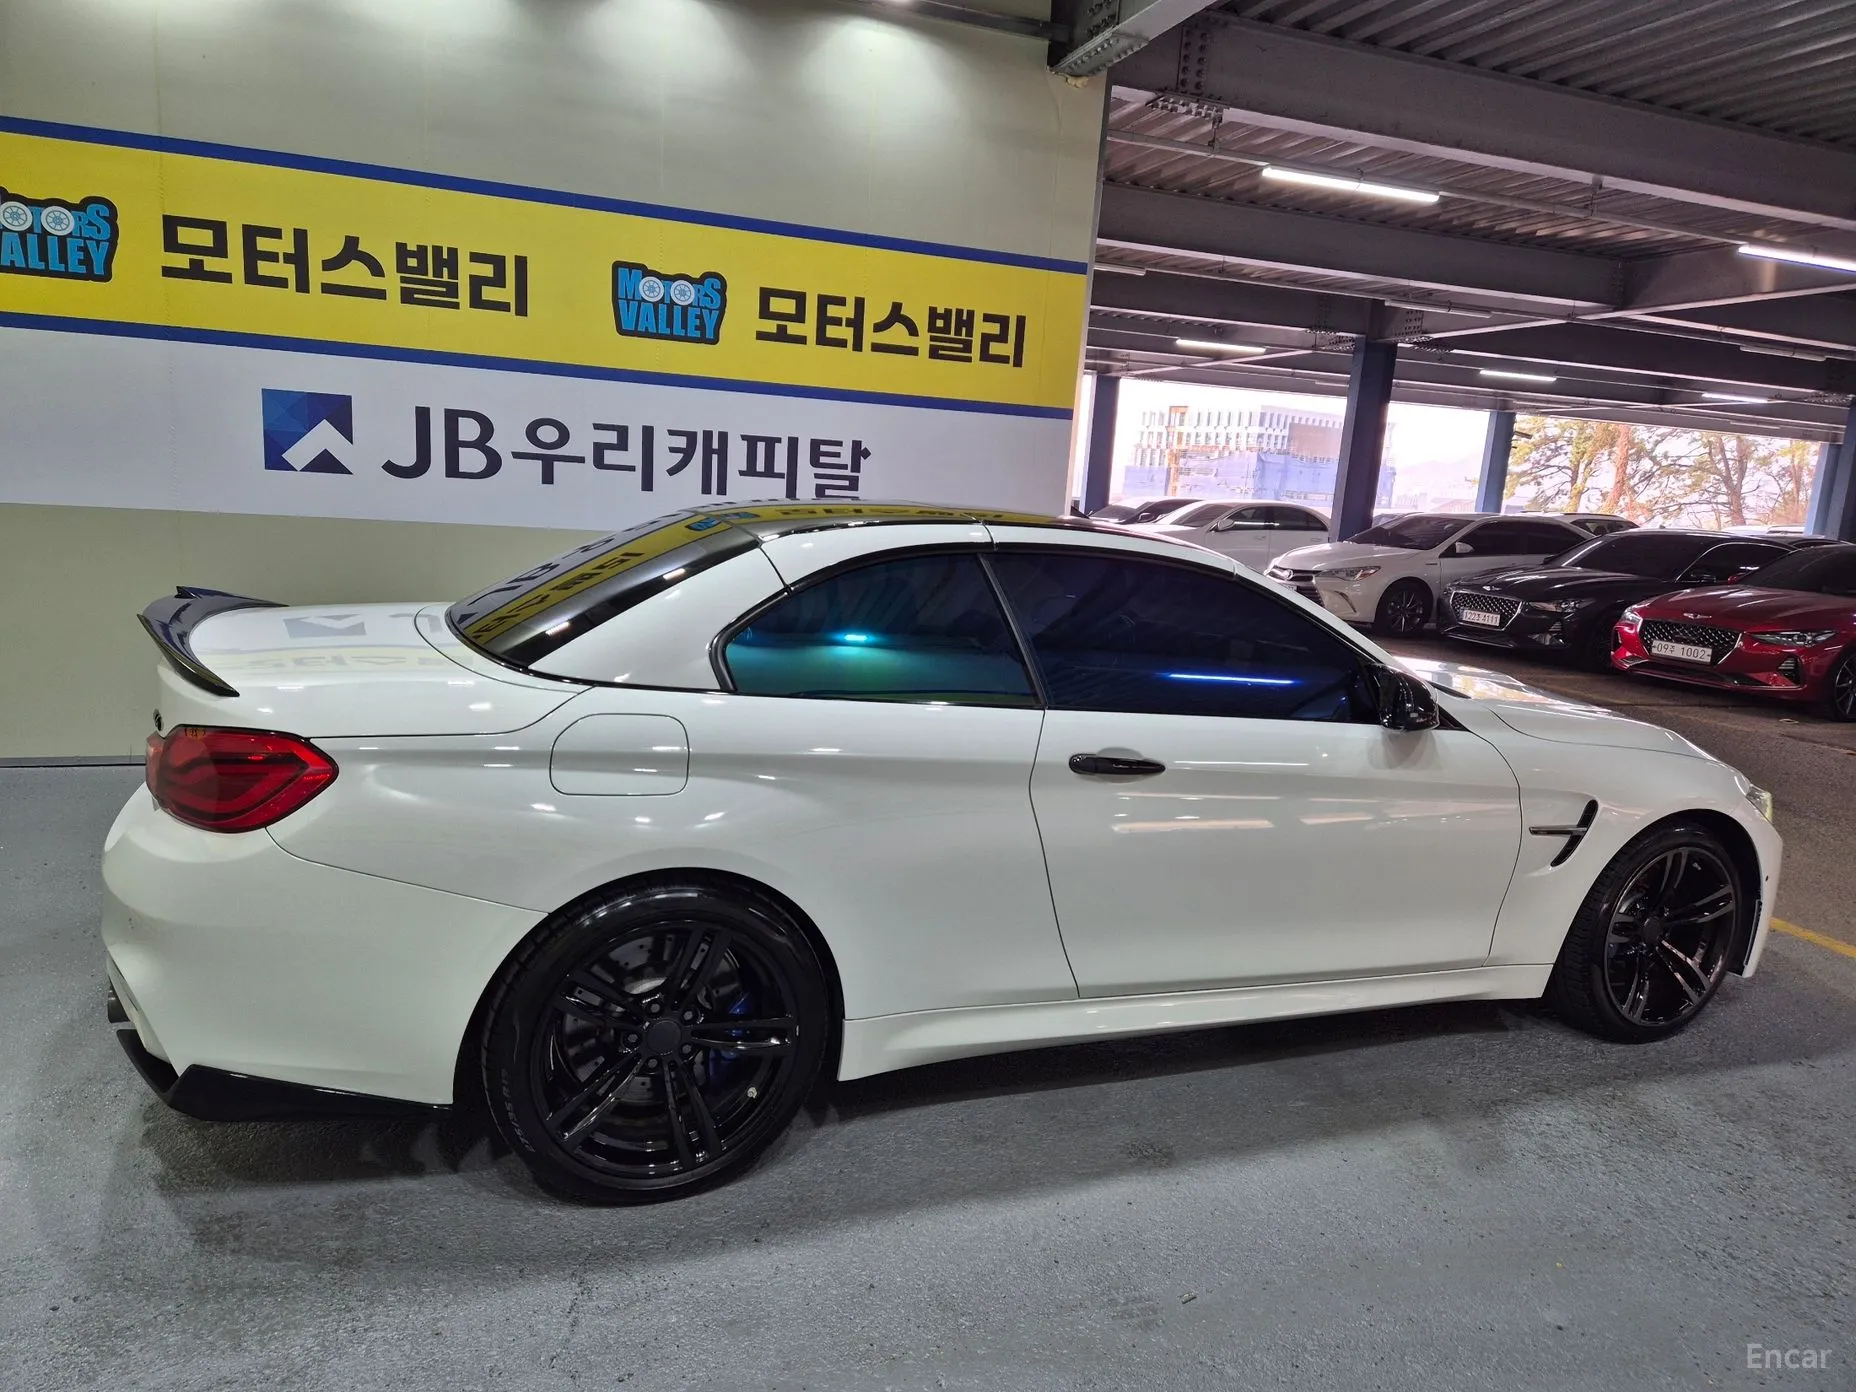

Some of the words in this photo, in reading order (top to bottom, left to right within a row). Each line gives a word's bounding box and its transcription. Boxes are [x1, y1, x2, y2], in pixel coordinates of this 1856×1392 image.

[0, 201, 111, 240] OTORS
[0, 231, 109, 275] ALLEY
[161, 214, 529, 317] 모터스밸리
[618, 267, 721, 310] MOTORS
[618, 299, 719, 339] VALLEY
[755, 286, 1026, 368] 모터스밸리
[381, 406, 872, 500] JB우리캐피탈
[1680, 646, 1706, 660] 1002
